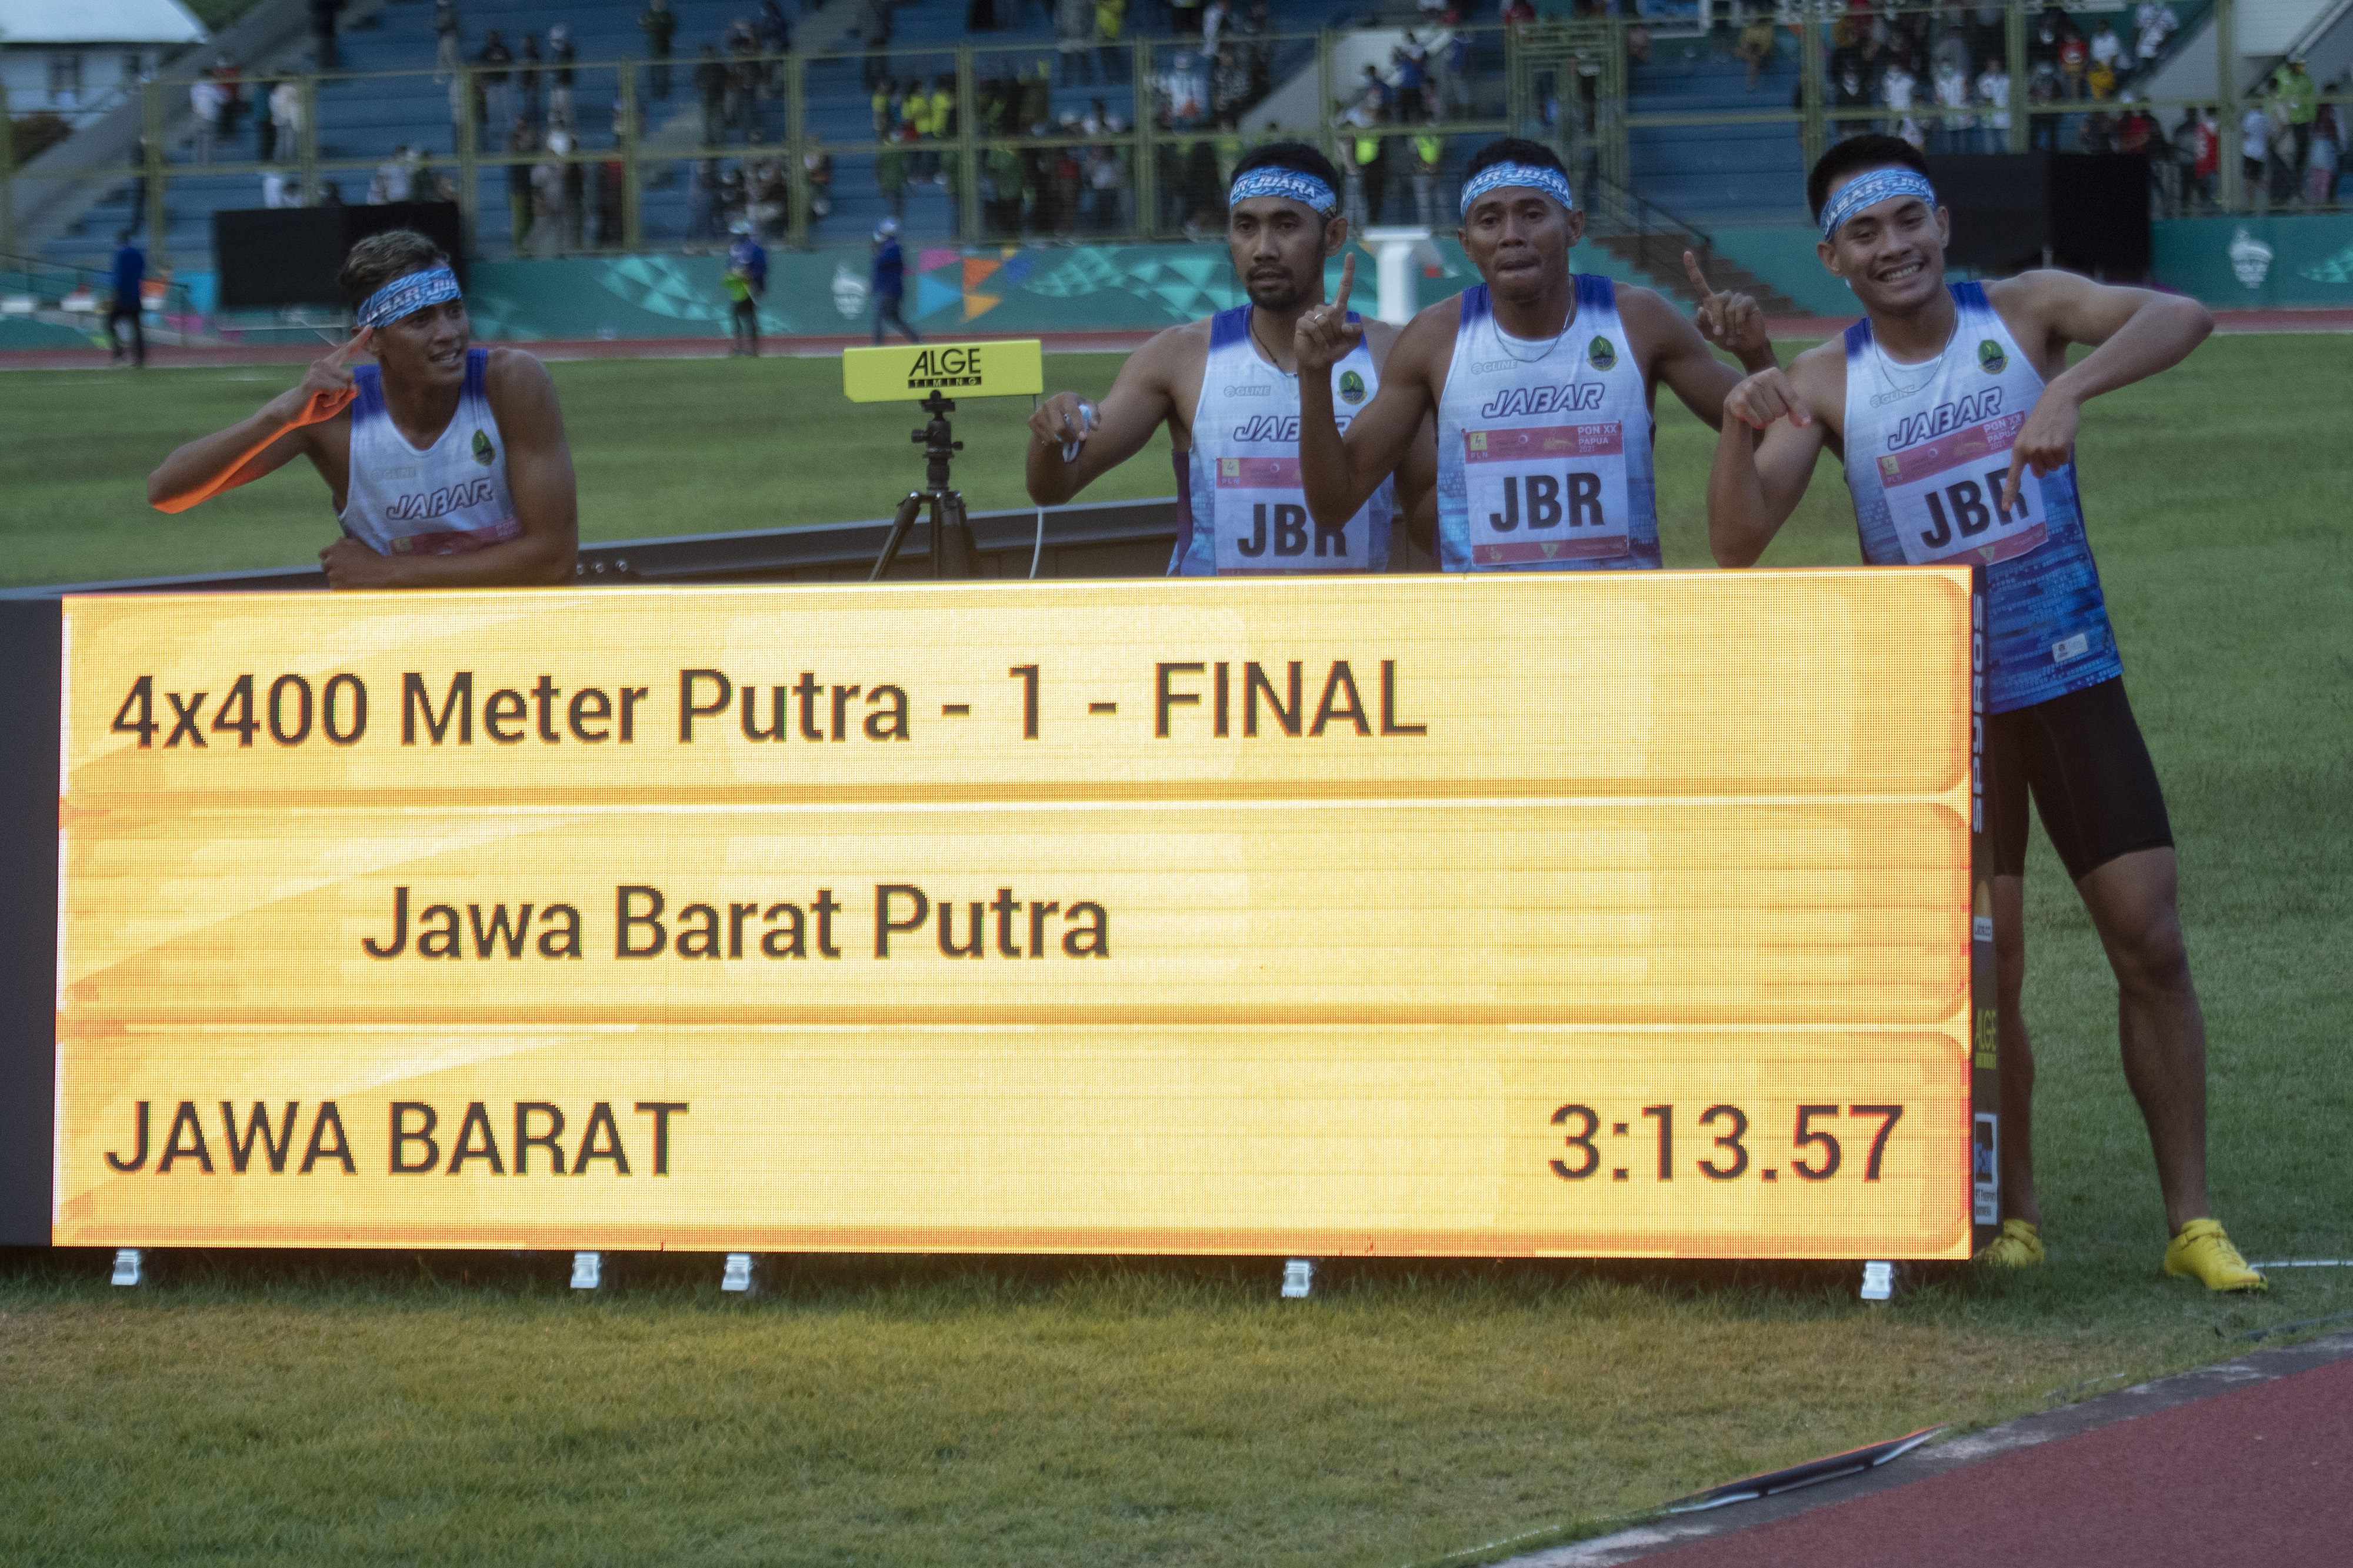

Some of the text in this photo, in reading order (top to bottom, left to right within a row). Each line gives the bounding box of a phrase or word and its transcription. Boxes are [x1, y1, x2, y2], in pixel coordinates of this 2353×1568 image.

[1249, 176, 1315, 198] JUARA
[1506, 169, 1569, 201] JUARA
[908, 348, 982, 378] ALGE
[911, 376, 979, 389] TIMING
[1482, 382, 1605, 419] JABAR
[1887, 385, 2002, 452] JABAR
[1578, 424, 1617, 435] PON XX
[1578, 437, 1609, 446] PAPUA
[385, 476, 494, 521] JABAR
[1489, 472, 1606, 533] JBR
[1921, 467, 2029, 549] JBR
[112, 660, 1428, 748] 4x400 Meter Putra - 1 - FINAL
[1972, 593, 1984, 834] SPYROS
[362, 884, 1111, 959] Jawa Barat Putra
[1975, 1009, 1997, 1052] ALGE
[105, 1100, 1905, 1182] JAWA BARAT 3:13.57
